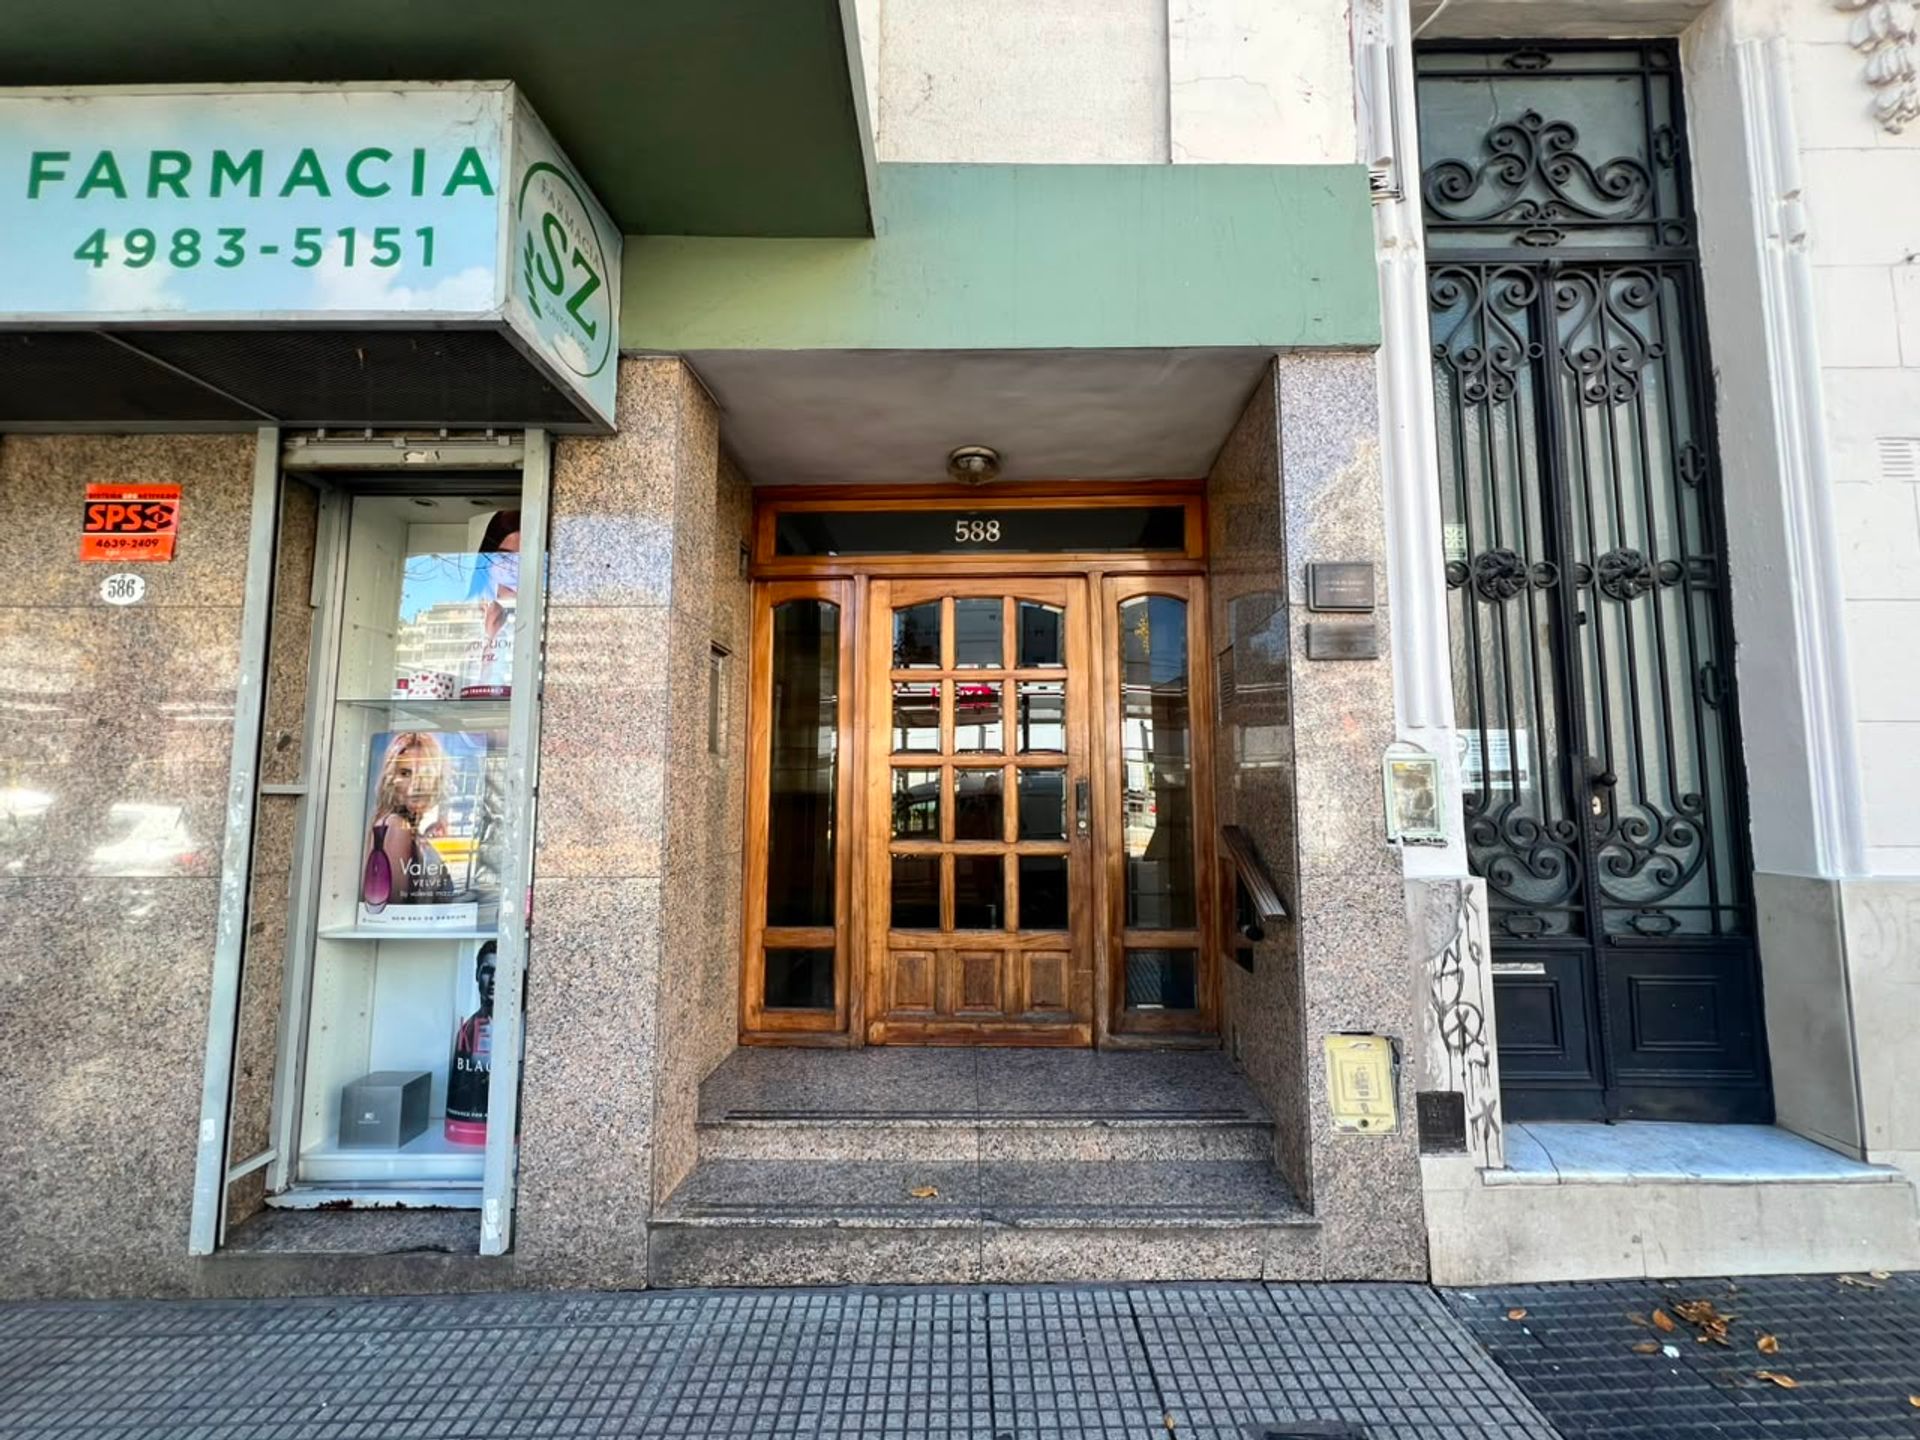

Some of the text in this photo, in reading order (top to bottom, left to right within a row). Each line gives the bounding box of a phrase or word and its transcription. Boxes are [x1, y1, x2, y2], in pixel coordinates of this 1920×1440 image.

[27, 146, 496, 199] FARMACIA
[540, 177, 600, 271] FARMACIA
[73, 226, 435, 268] 4983-5151
[535, 211, 601, 341] SZ
[86, 504, 142, 530] SPS
[954, 519, 1001, 542] 588
[107, 578, 136, 598] 586
[457, 1016, 494, 1055] KE
